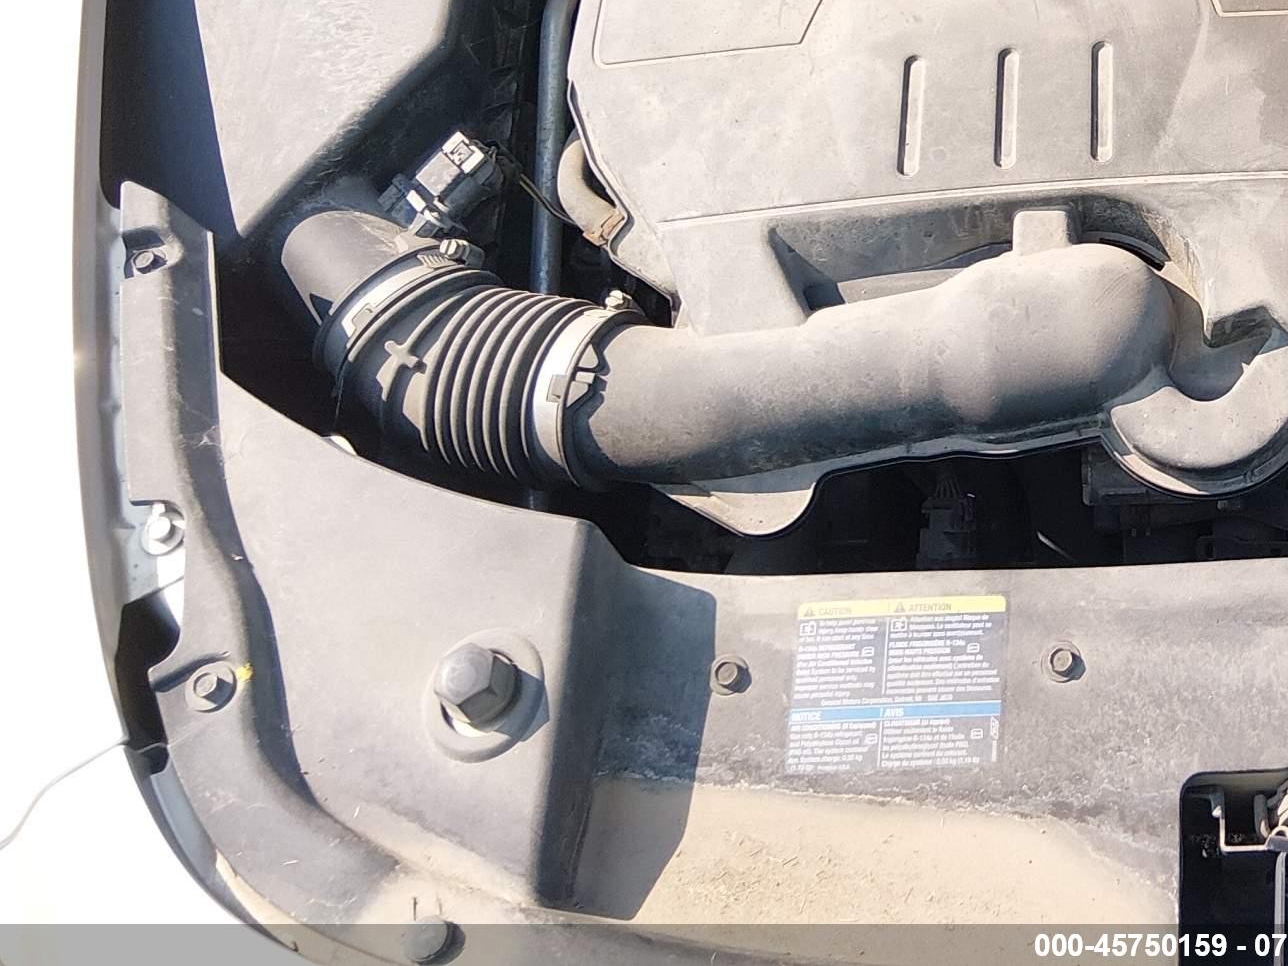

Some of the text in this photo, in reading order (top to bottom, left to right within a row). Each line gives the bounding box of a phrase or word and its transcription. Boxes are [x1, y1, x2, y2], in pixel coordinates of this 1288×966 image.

[818, 607, 852, 616] CAUTION
[908, 603, 952, 612] ATTENTION
[791, 710, 822, 721] NOTICE
[884, 708, 904, 717] AVIS
